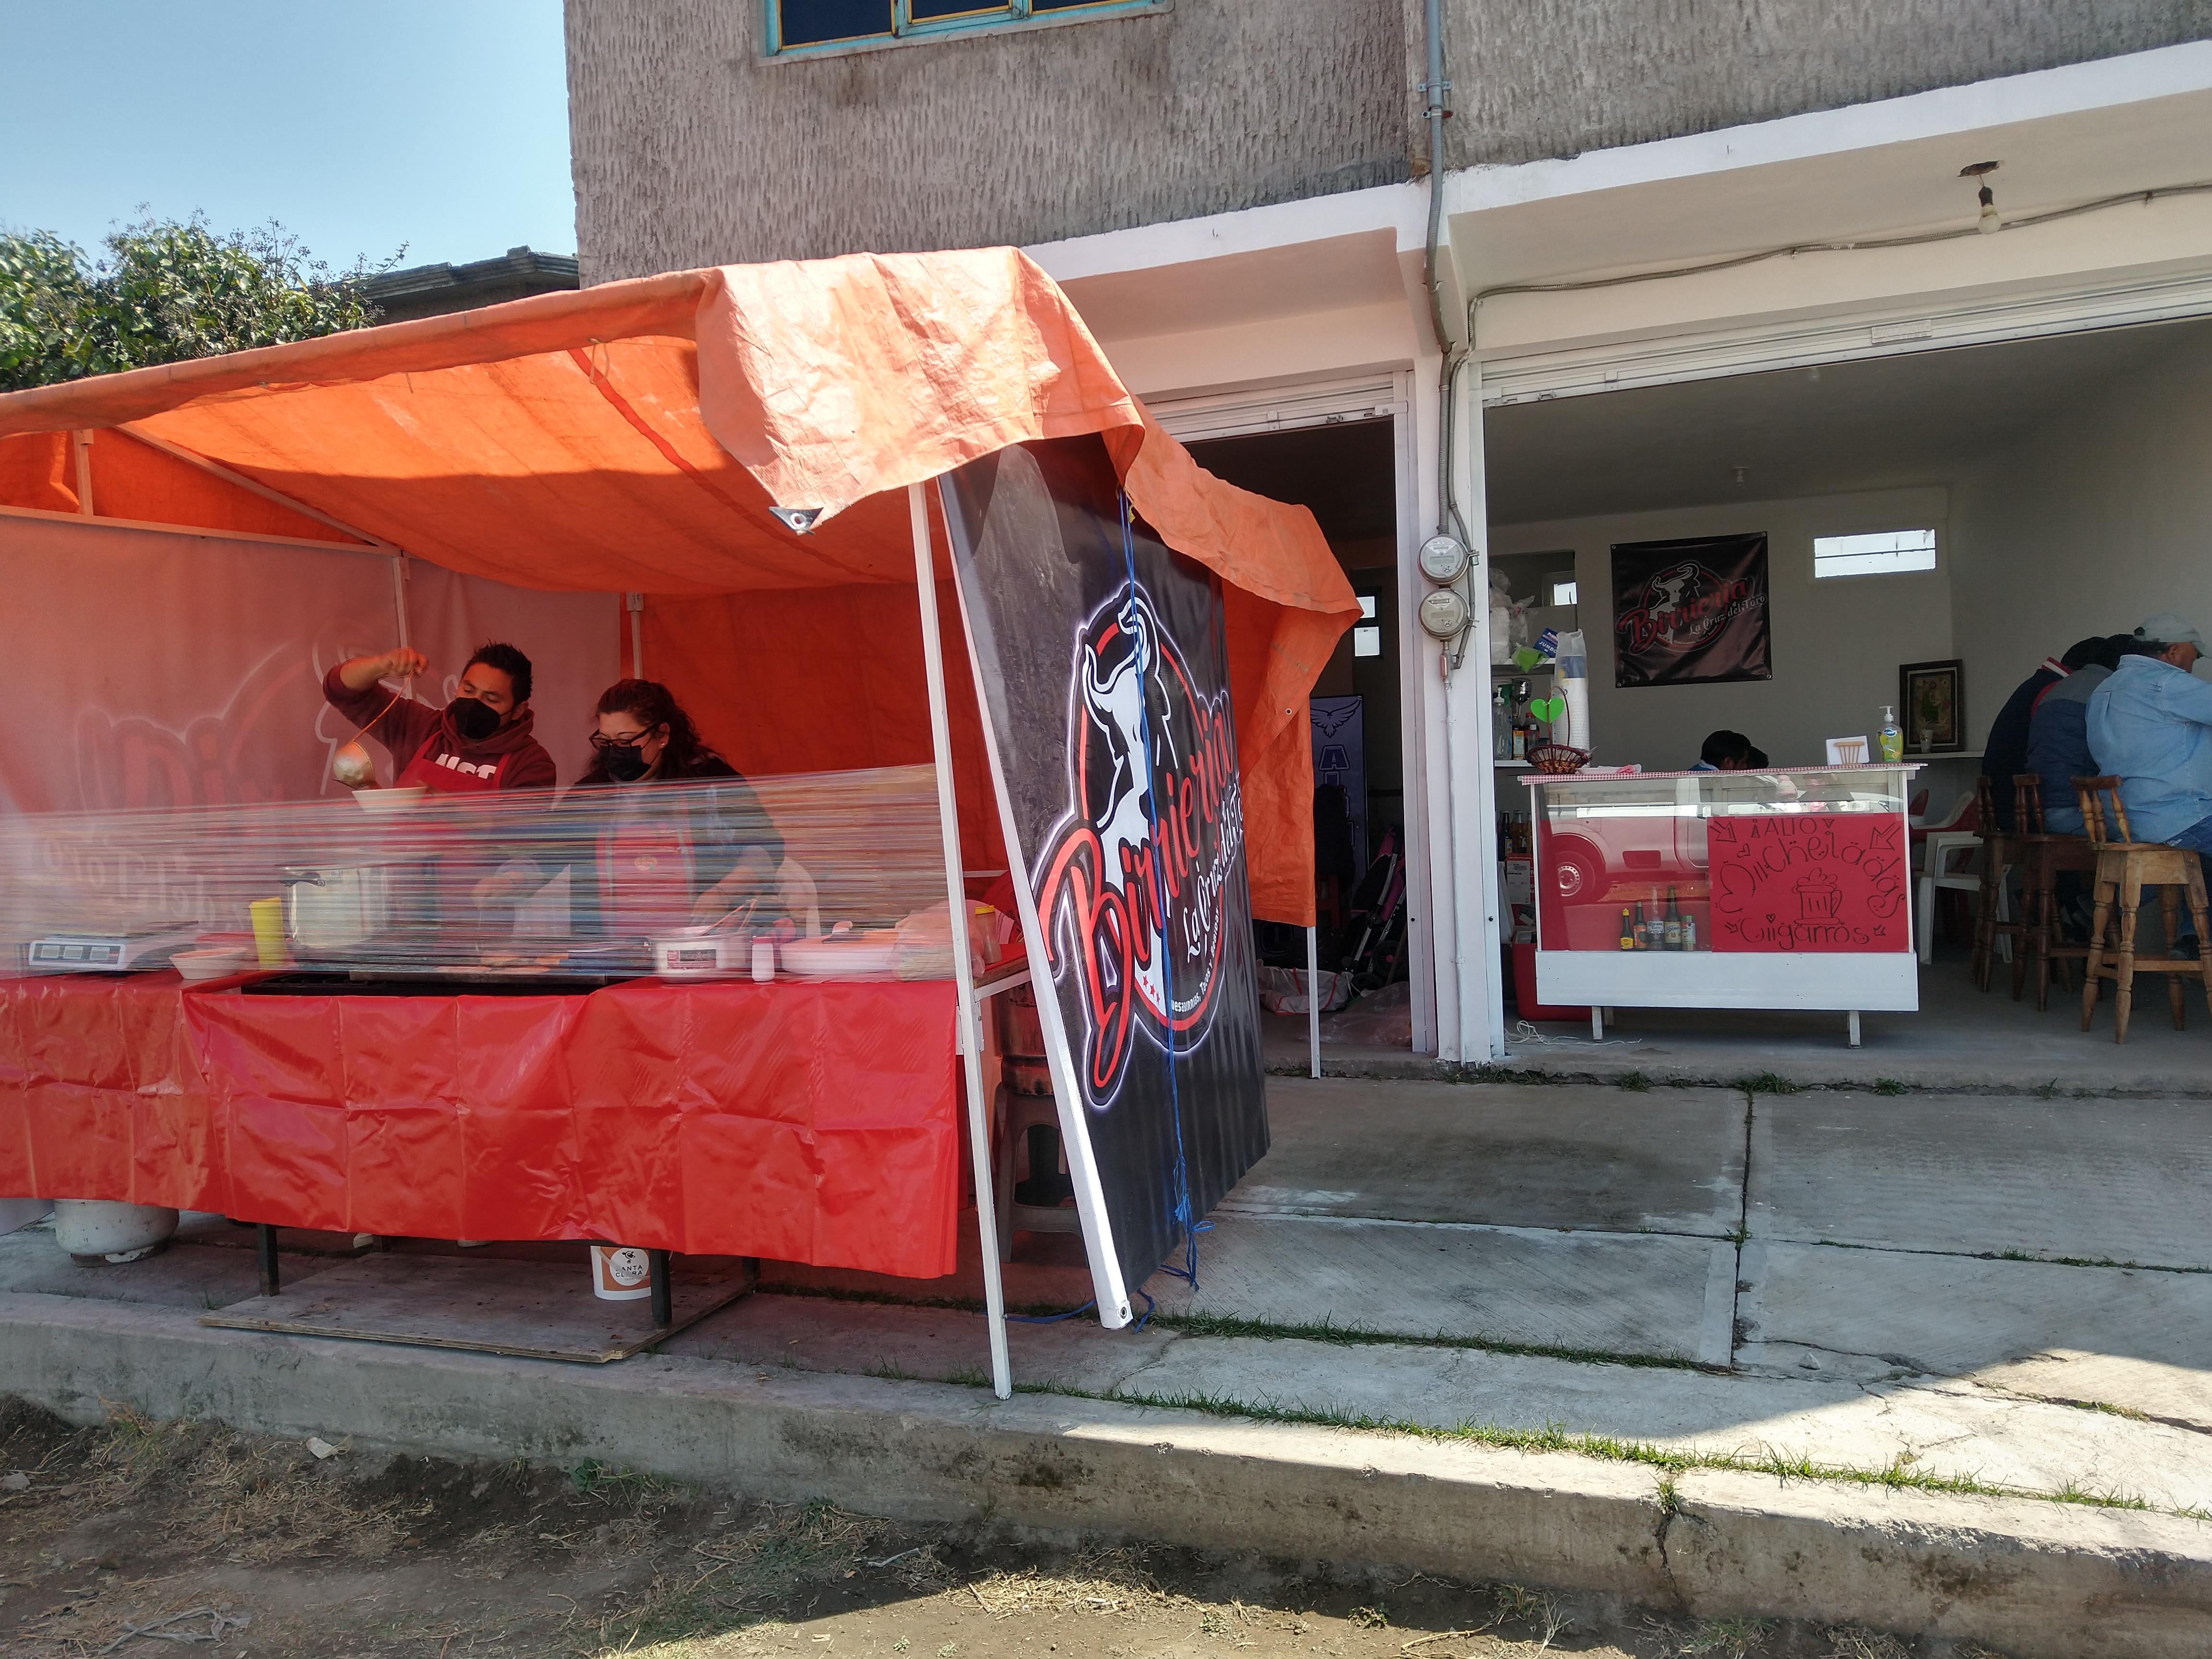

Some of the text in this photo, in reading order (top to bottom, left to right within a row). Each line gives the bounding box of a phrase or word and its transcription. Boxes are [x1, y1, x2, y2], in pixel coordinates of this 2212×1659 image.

[1539, 641, 1557, 653] JUMBO
[1620, 579, 1748, 652] Birrieria
[1690, 624, 1701, 636] La
[1704, 613, 1727, 634] Cruz
[1728, 606, 1742, 618] del
[1741, 595, 1765, 611] Toro
[1038, 706, 1233, 1088] Birrieria
[1183, 907, 1201, 964] La
[1197, 852, 1223, 958] Cruz
[1220, 807, 1234, 867] del
